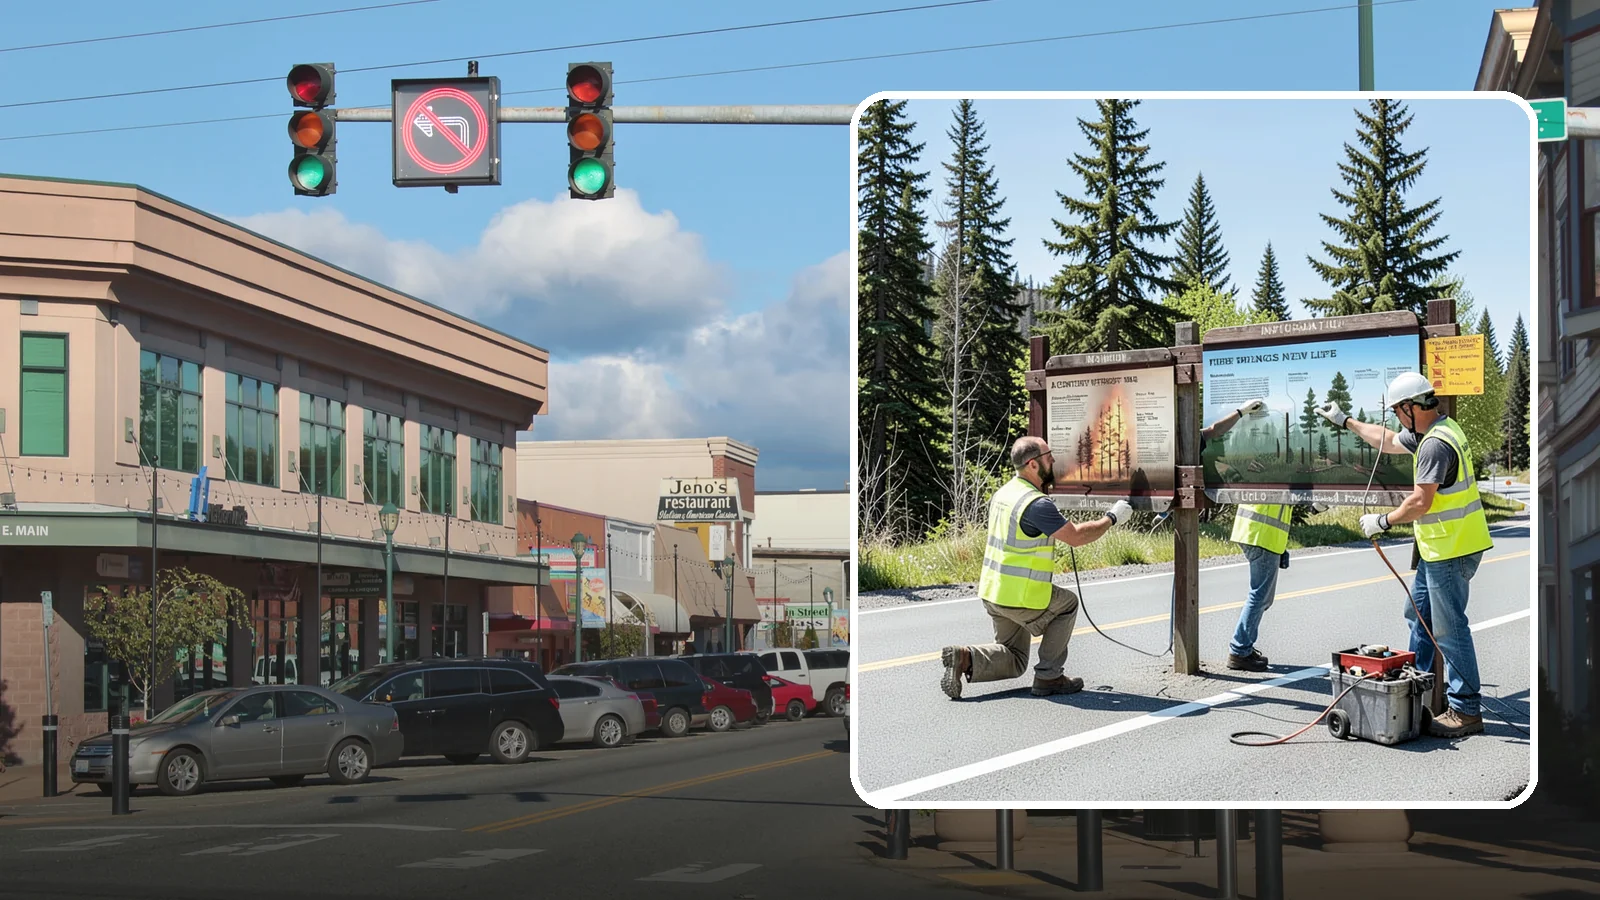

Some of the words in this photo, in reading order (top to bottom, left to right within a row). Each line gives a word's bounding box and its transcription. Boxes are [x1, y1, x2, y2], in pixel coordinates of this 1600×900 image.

[669, 479, 728, 494] Jeno's
[665, 496, 731, 509] restaurant
[715, 509, 738, 519] Cuisine
[2, 525, 13, 536] E.
[15, 525, 49, 536] MAIN
[797, 607, 828, 617] Street
